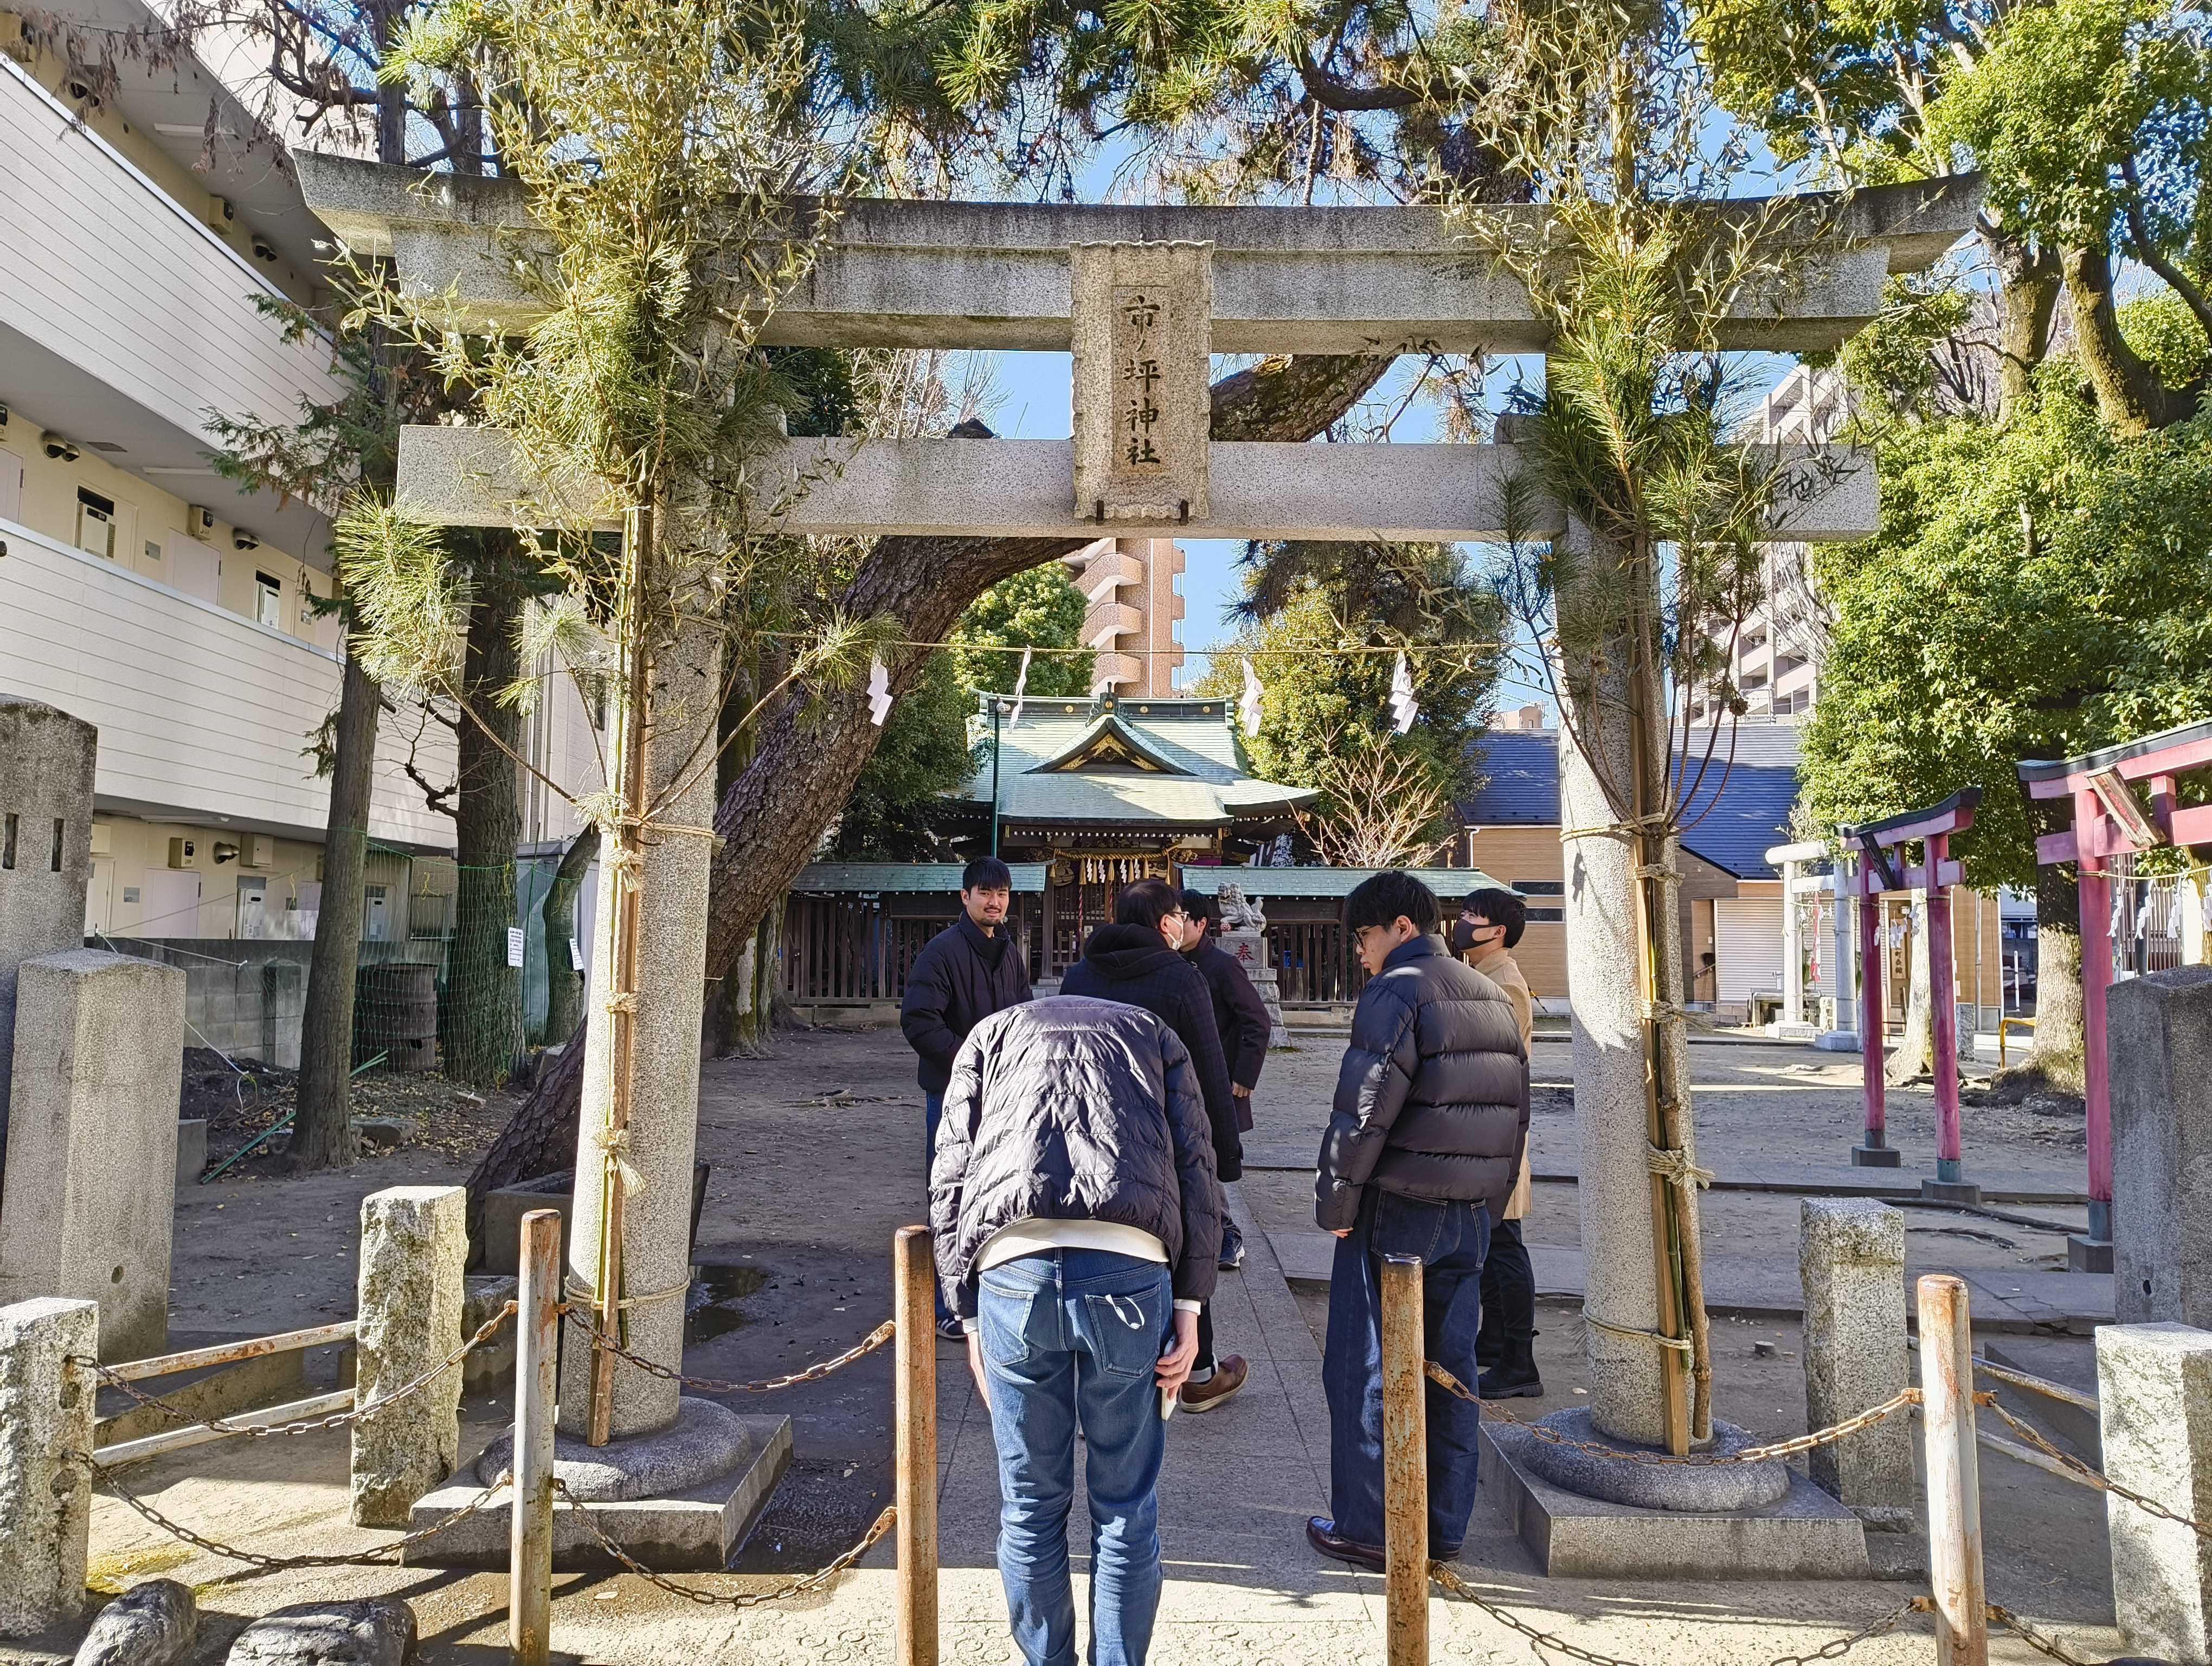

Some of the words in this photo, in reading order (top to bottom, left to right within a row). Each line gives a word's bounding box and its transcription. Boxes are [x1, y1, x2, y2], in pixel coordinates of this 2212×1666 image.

[1121, 295, 1161, 466] 市ノ坪神社
[1234, 942, 1255, 963] 奉
